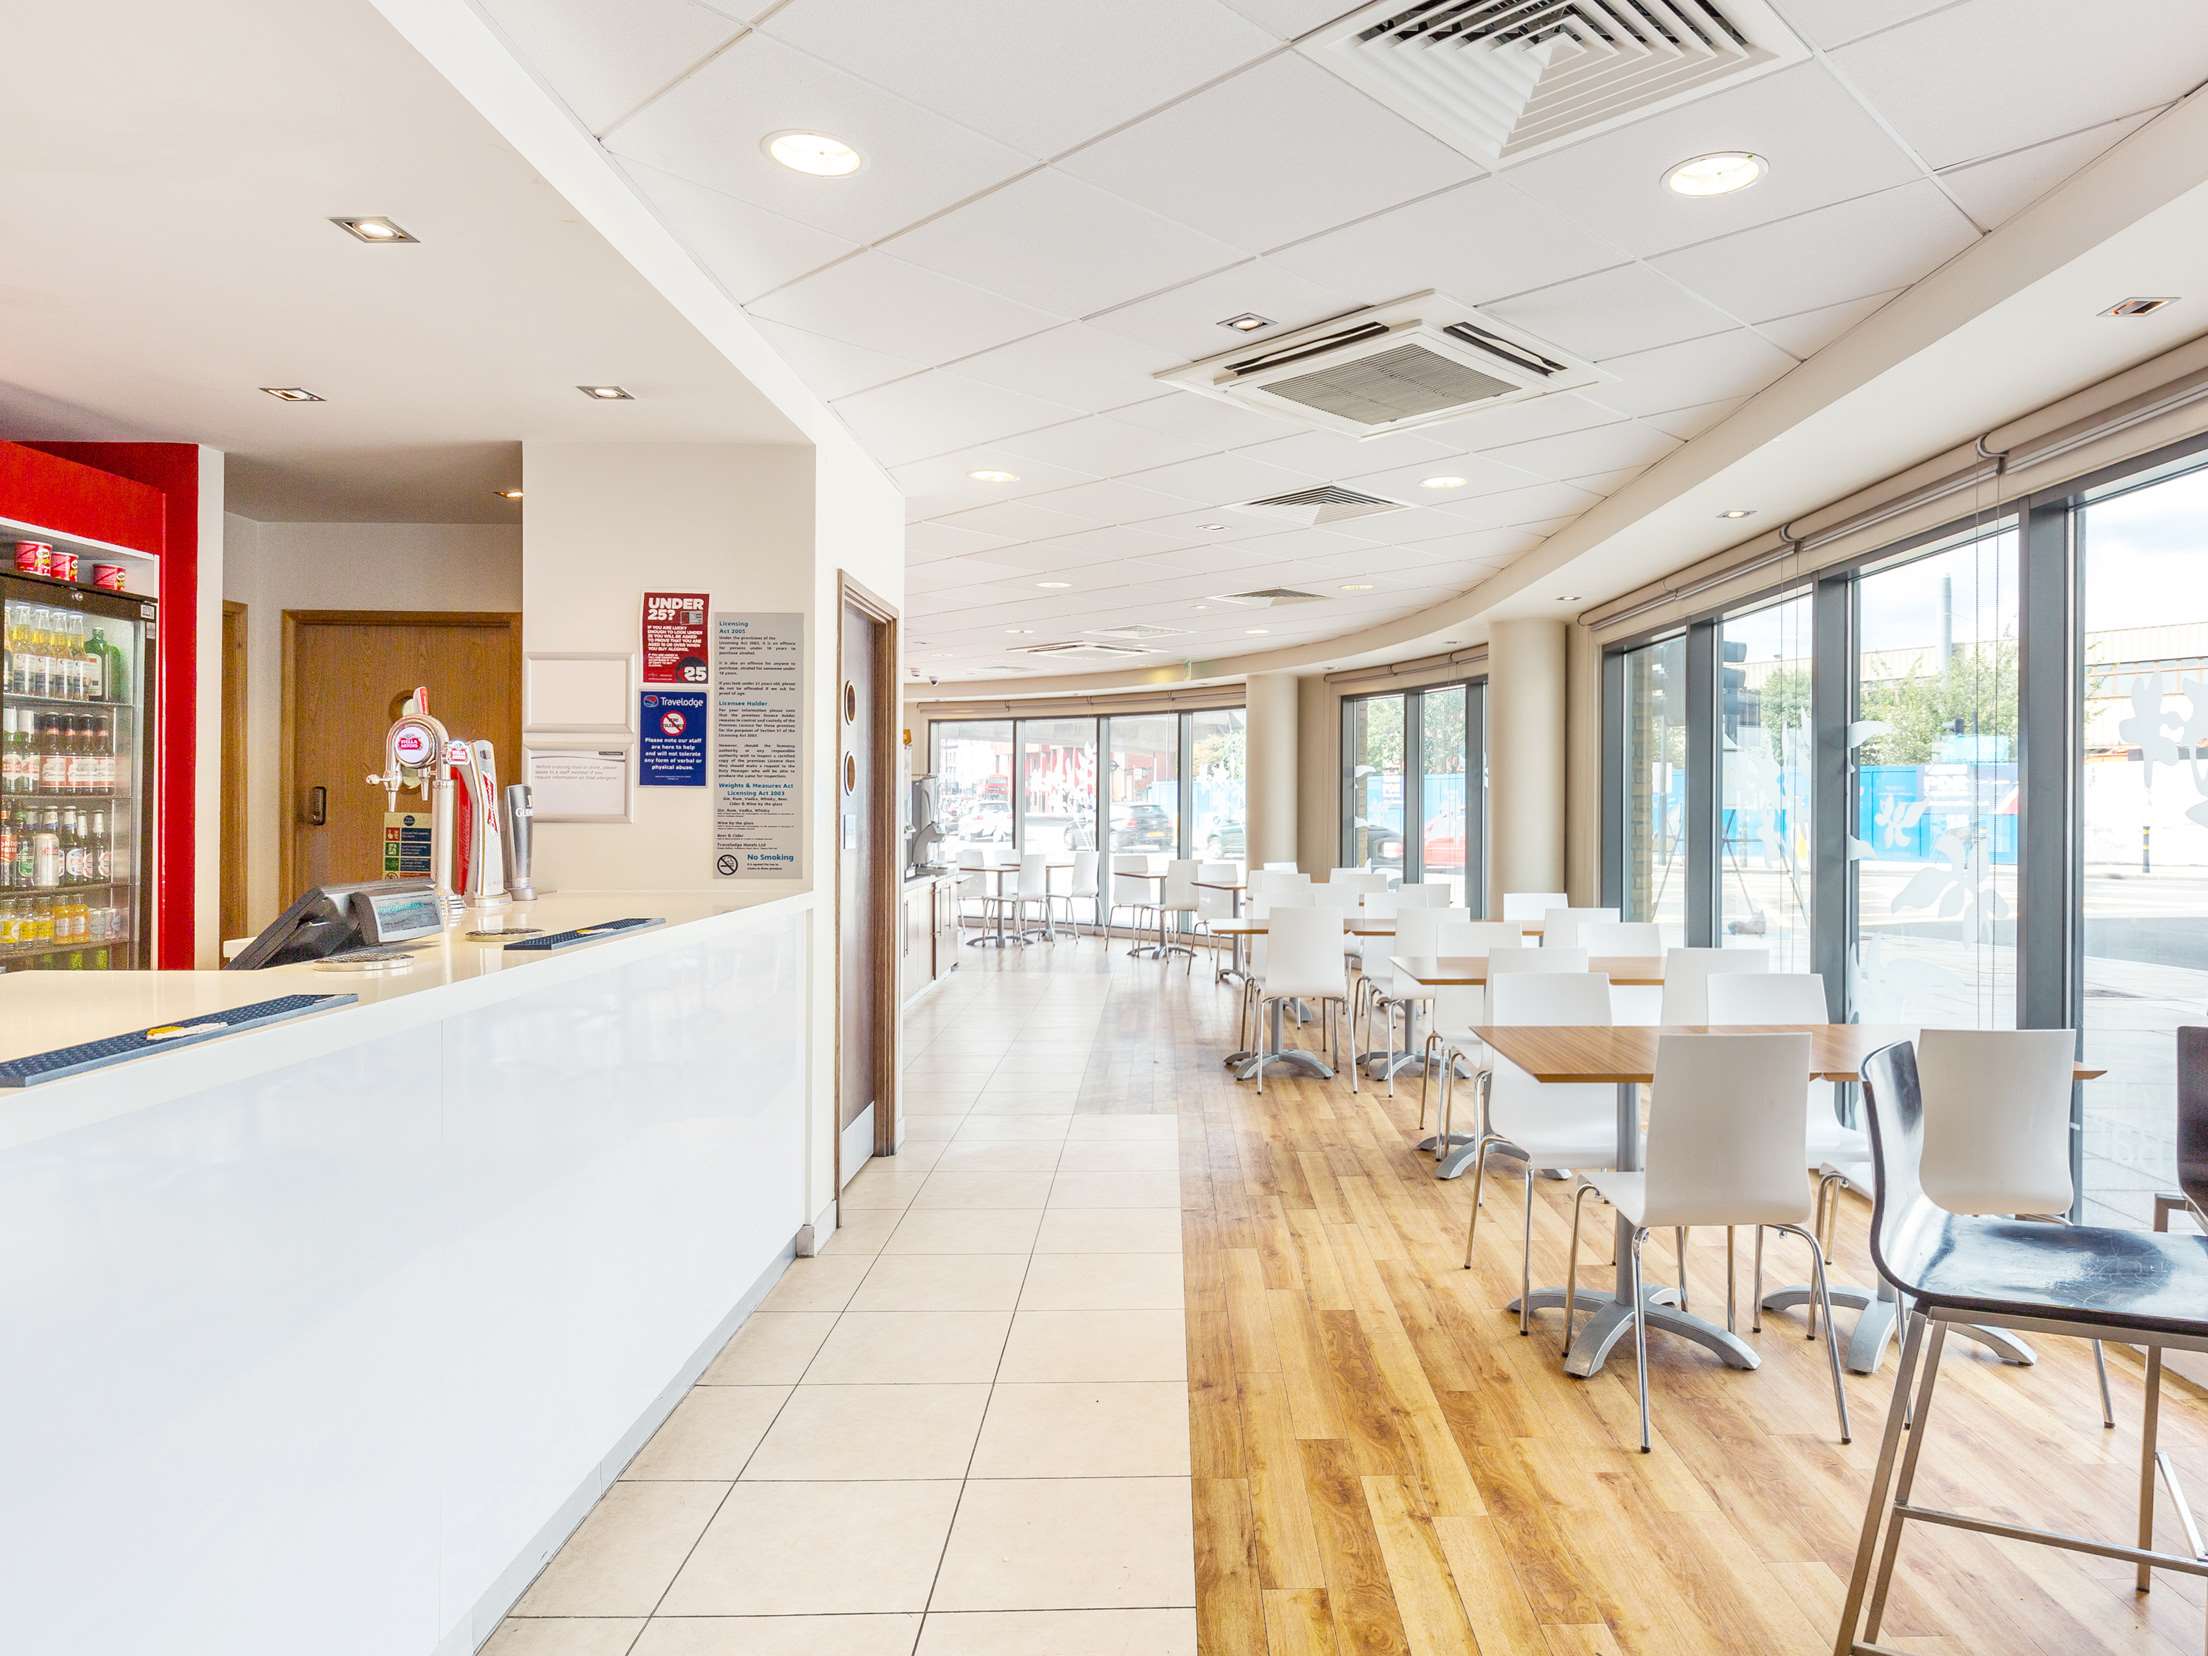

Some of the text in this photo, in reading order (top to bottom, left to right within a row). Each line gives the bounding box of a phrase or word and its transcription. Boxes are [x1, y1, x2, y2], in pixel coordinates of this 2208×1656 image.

[648, 598, 704, 610] UNDER
[648, 609, 675, 620] 25?
[684, 667, 706, 681] 25
[660, 697, 703, 708] Travelodge
[748, 854, 794, 862] No Smoking
